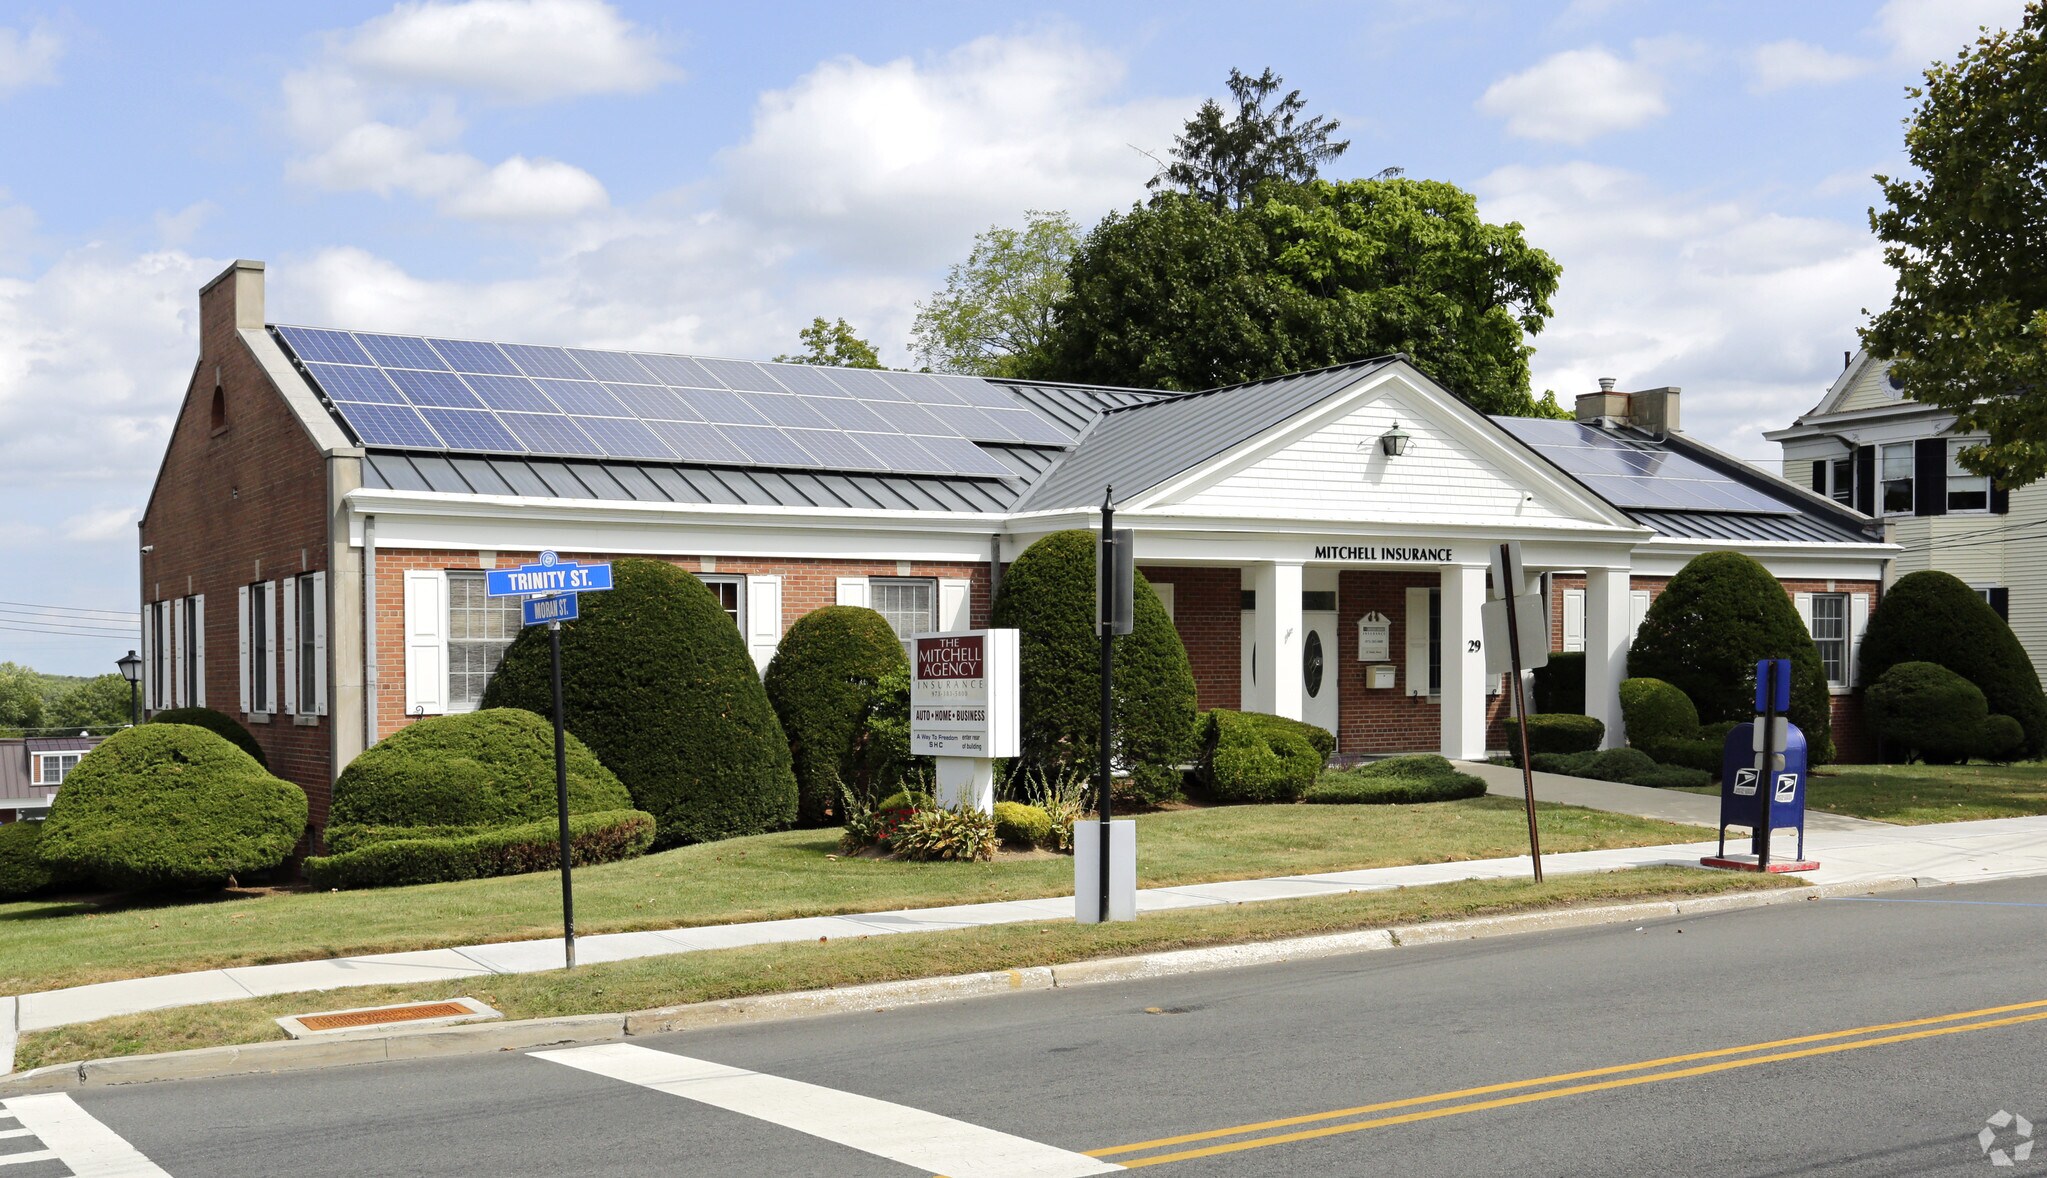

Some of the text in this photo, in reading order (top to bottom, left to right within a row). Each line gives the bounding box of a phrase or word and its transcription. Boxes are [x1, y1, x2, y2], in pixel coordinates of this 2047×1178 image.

[1315, 546, 1453, 561] MITCHELL INSURANCE
[508, 569, 592, 591] TRINITY ST.
[534, 598, 569, 620] MORAN ST.
[940, 638, 960, 648] THE
[1468, 640, 1481, 653] 29
[919, 647, 981, 663] MITCHELL
[923, 662, 977, 677] AGENCY
[917, 680, 984, 689] INSURANCE
[916, 710, 985, 722] AUTO HOME BUSINESS
[929, 741, 944, 749] SHC
